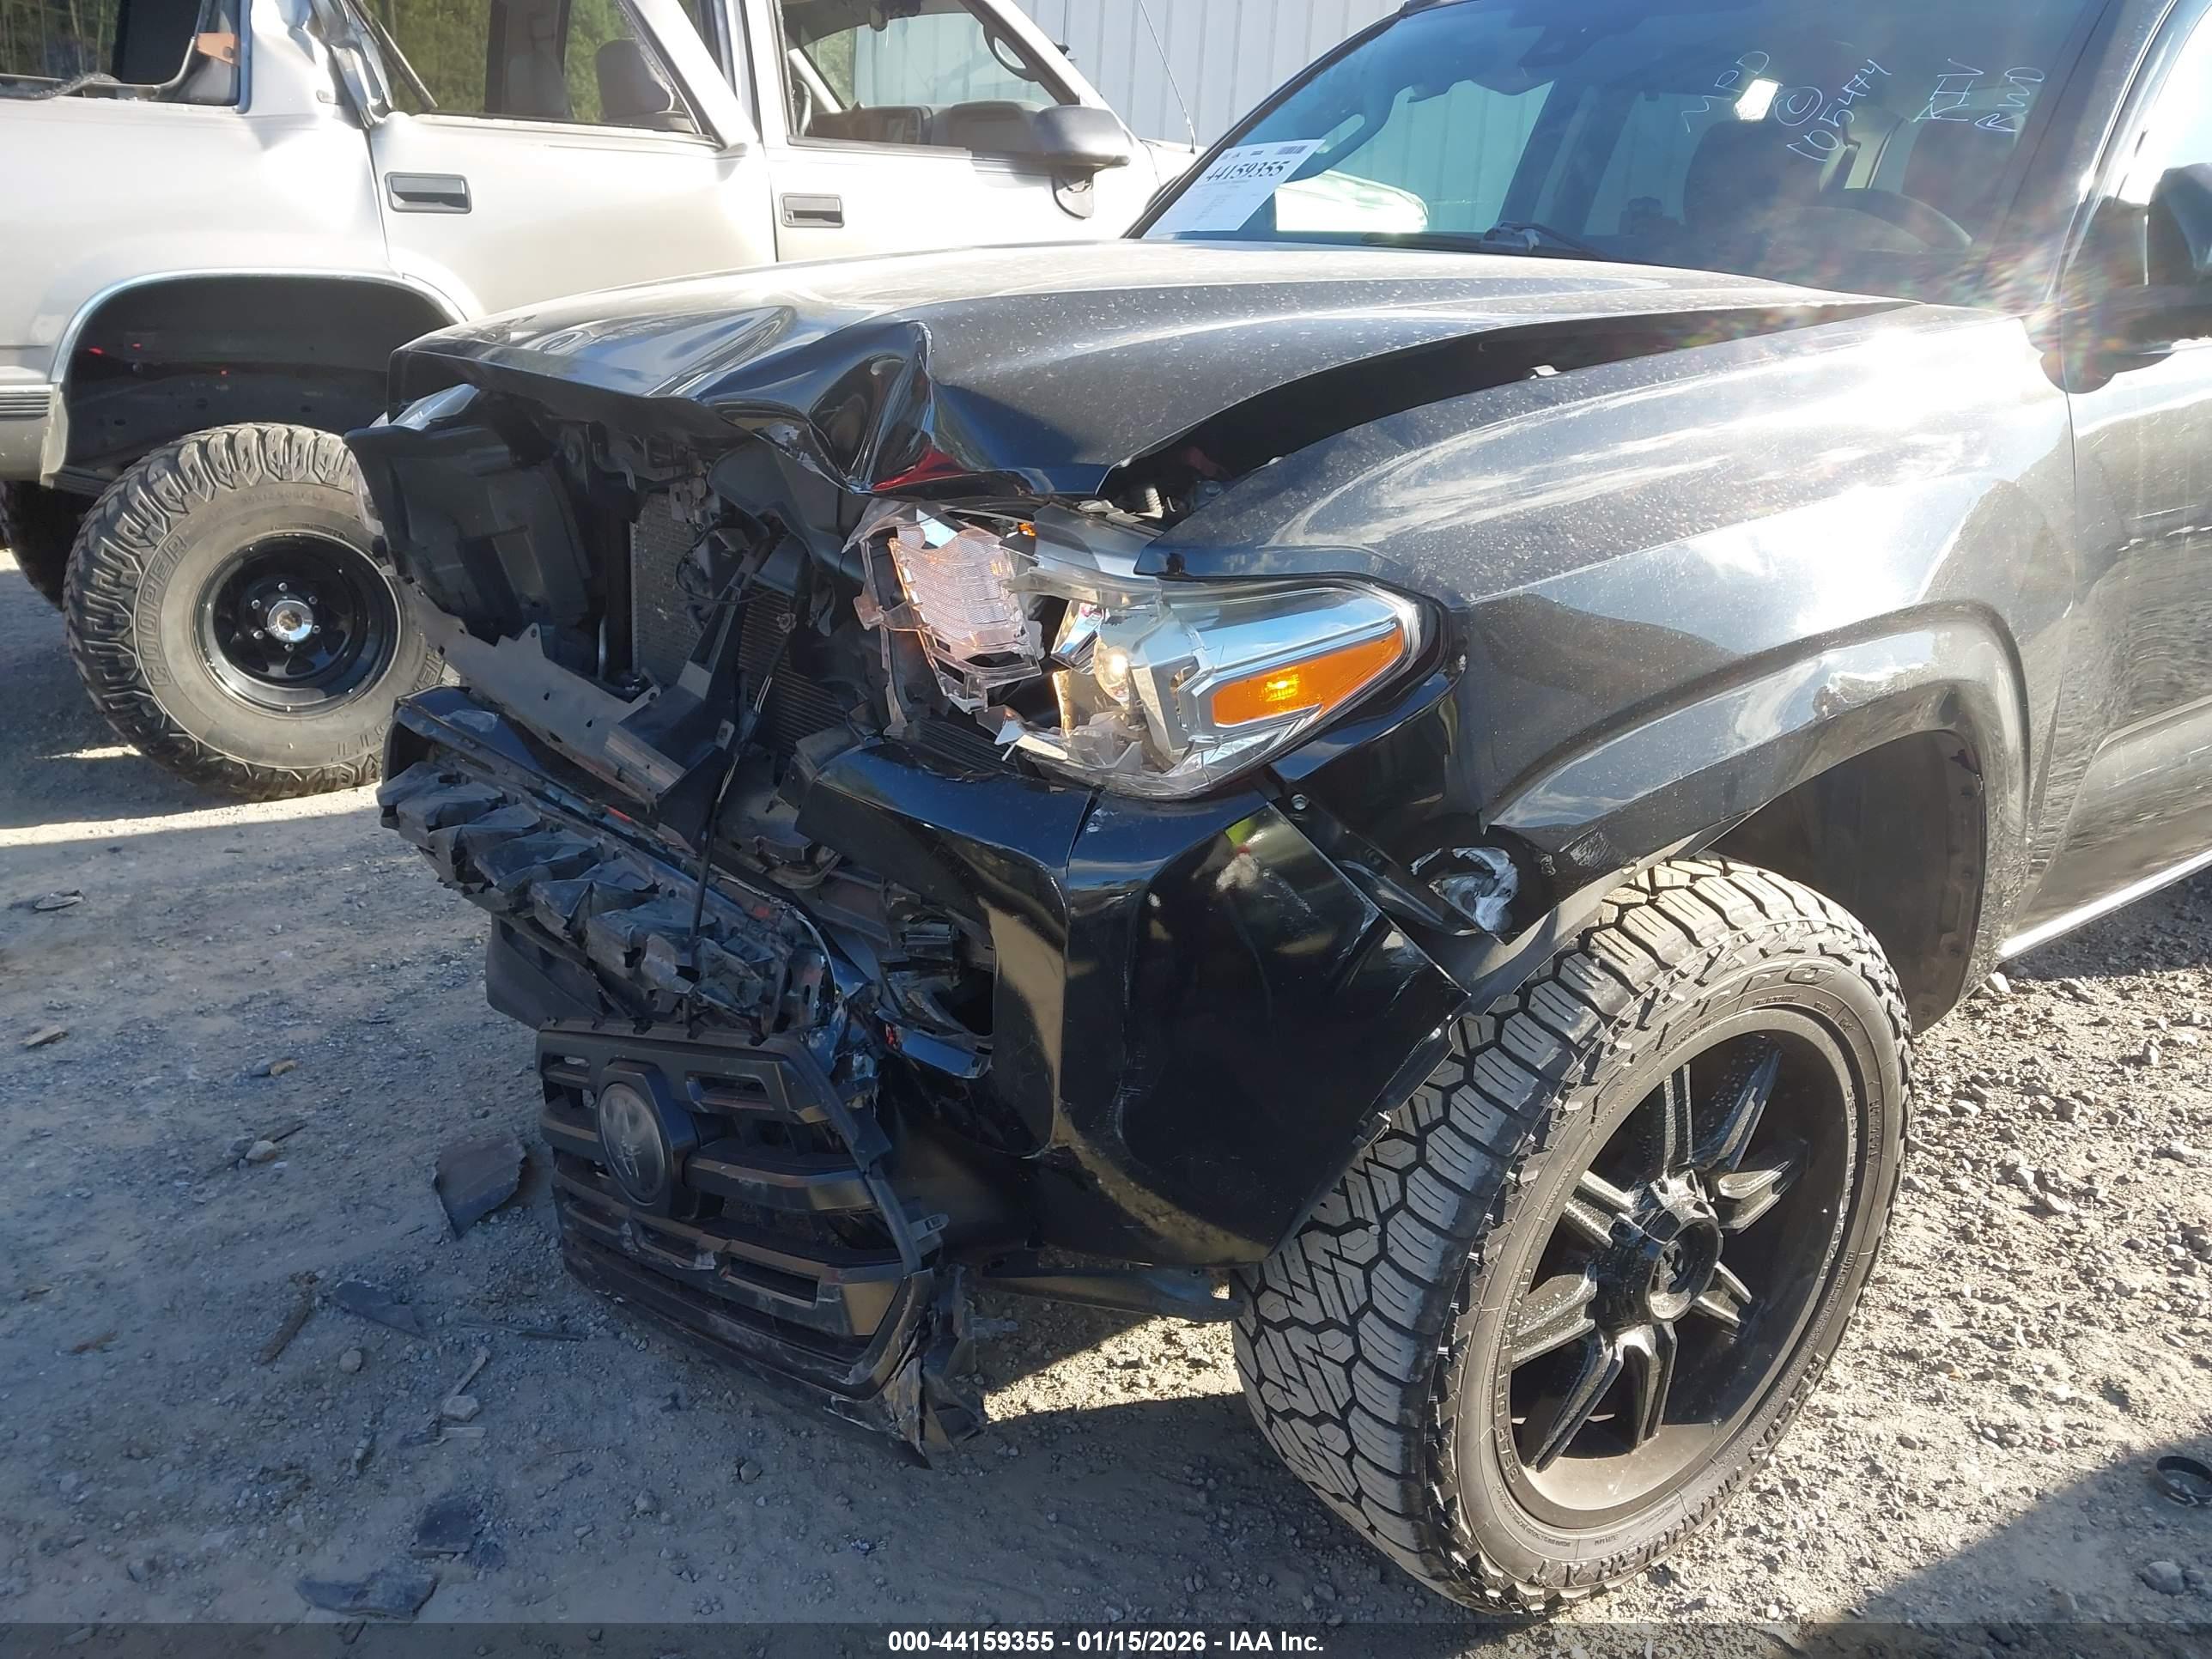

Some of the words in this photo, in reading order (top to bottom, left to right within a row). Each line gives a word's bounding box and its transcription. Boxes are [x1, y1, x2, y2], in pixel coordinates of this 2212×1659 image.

[1206, 161, 1290, 181] 44159355
[137, 534, 188, 686] COOPER
[1500, 1267, 1533, 1352] ROAD
[1493, 1359, 1509, 1422] OFF
[1494, 1422, 1522, 1486] GEAR
